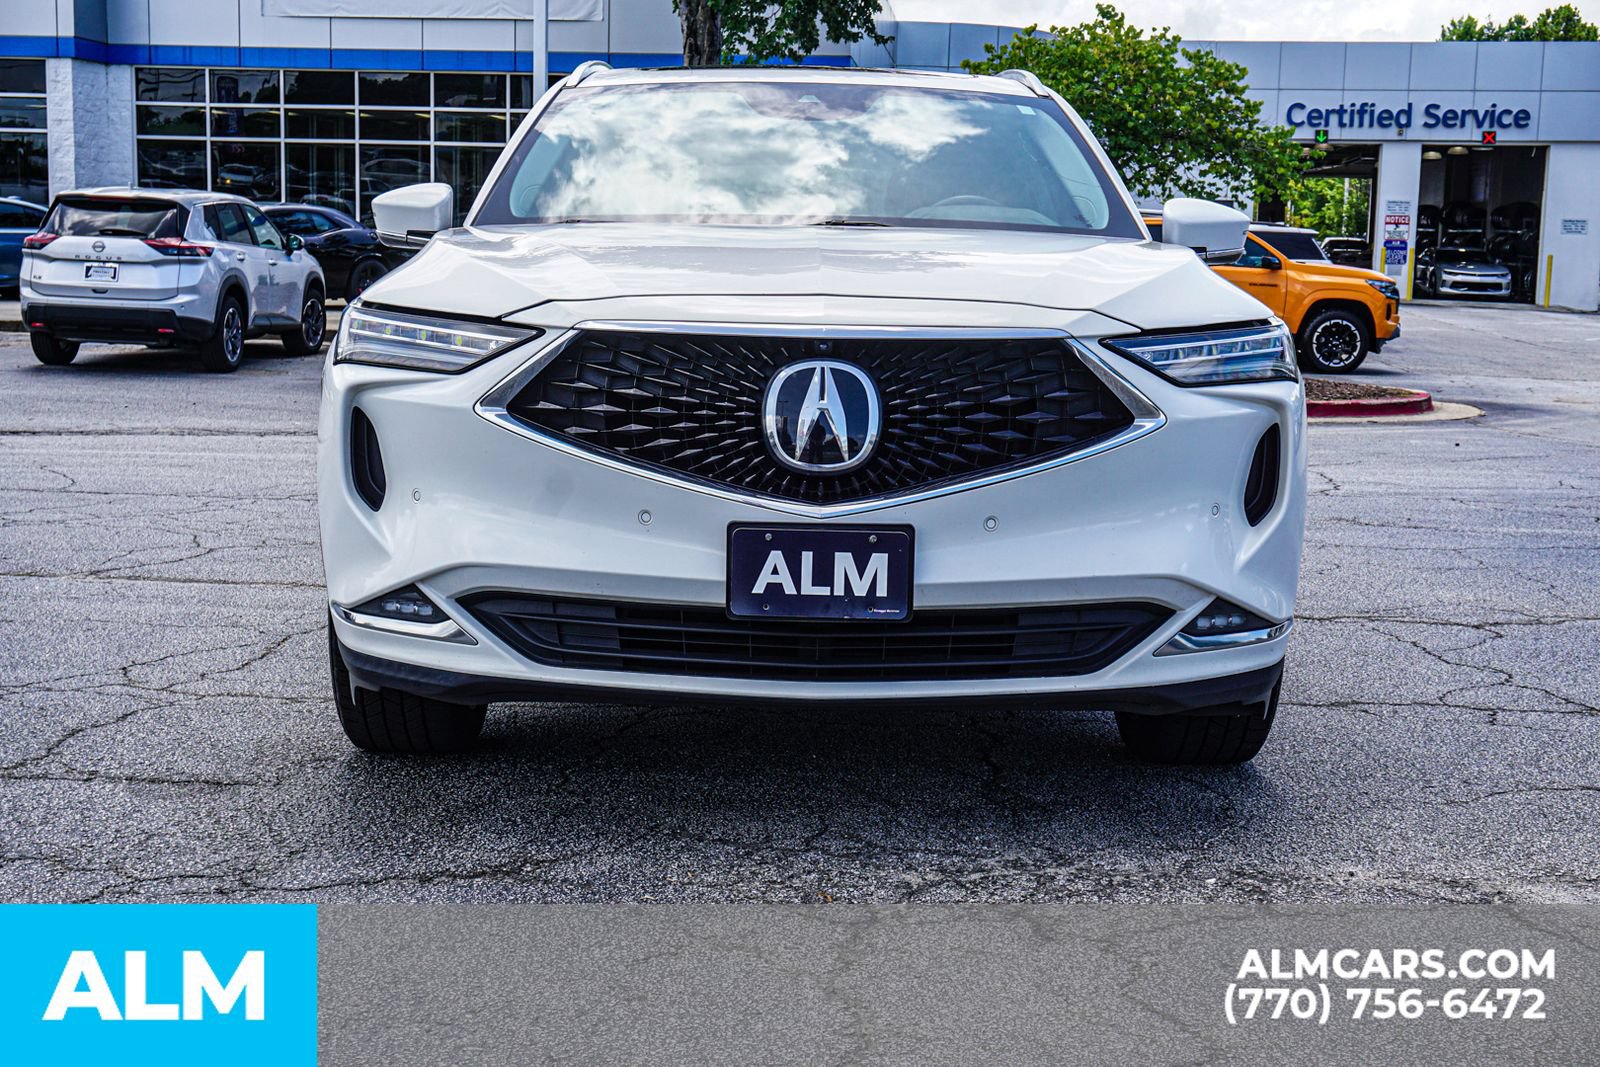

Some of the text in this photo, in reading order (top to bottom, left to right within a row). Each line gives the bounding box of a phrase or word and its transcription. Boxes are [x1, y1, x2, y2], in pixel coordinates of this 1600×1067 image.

[1286, 102, 1532, 129] Certified Service
[1386, 216, 1409, 224] NOTICE
[751, 550, 889, 597] ALM
